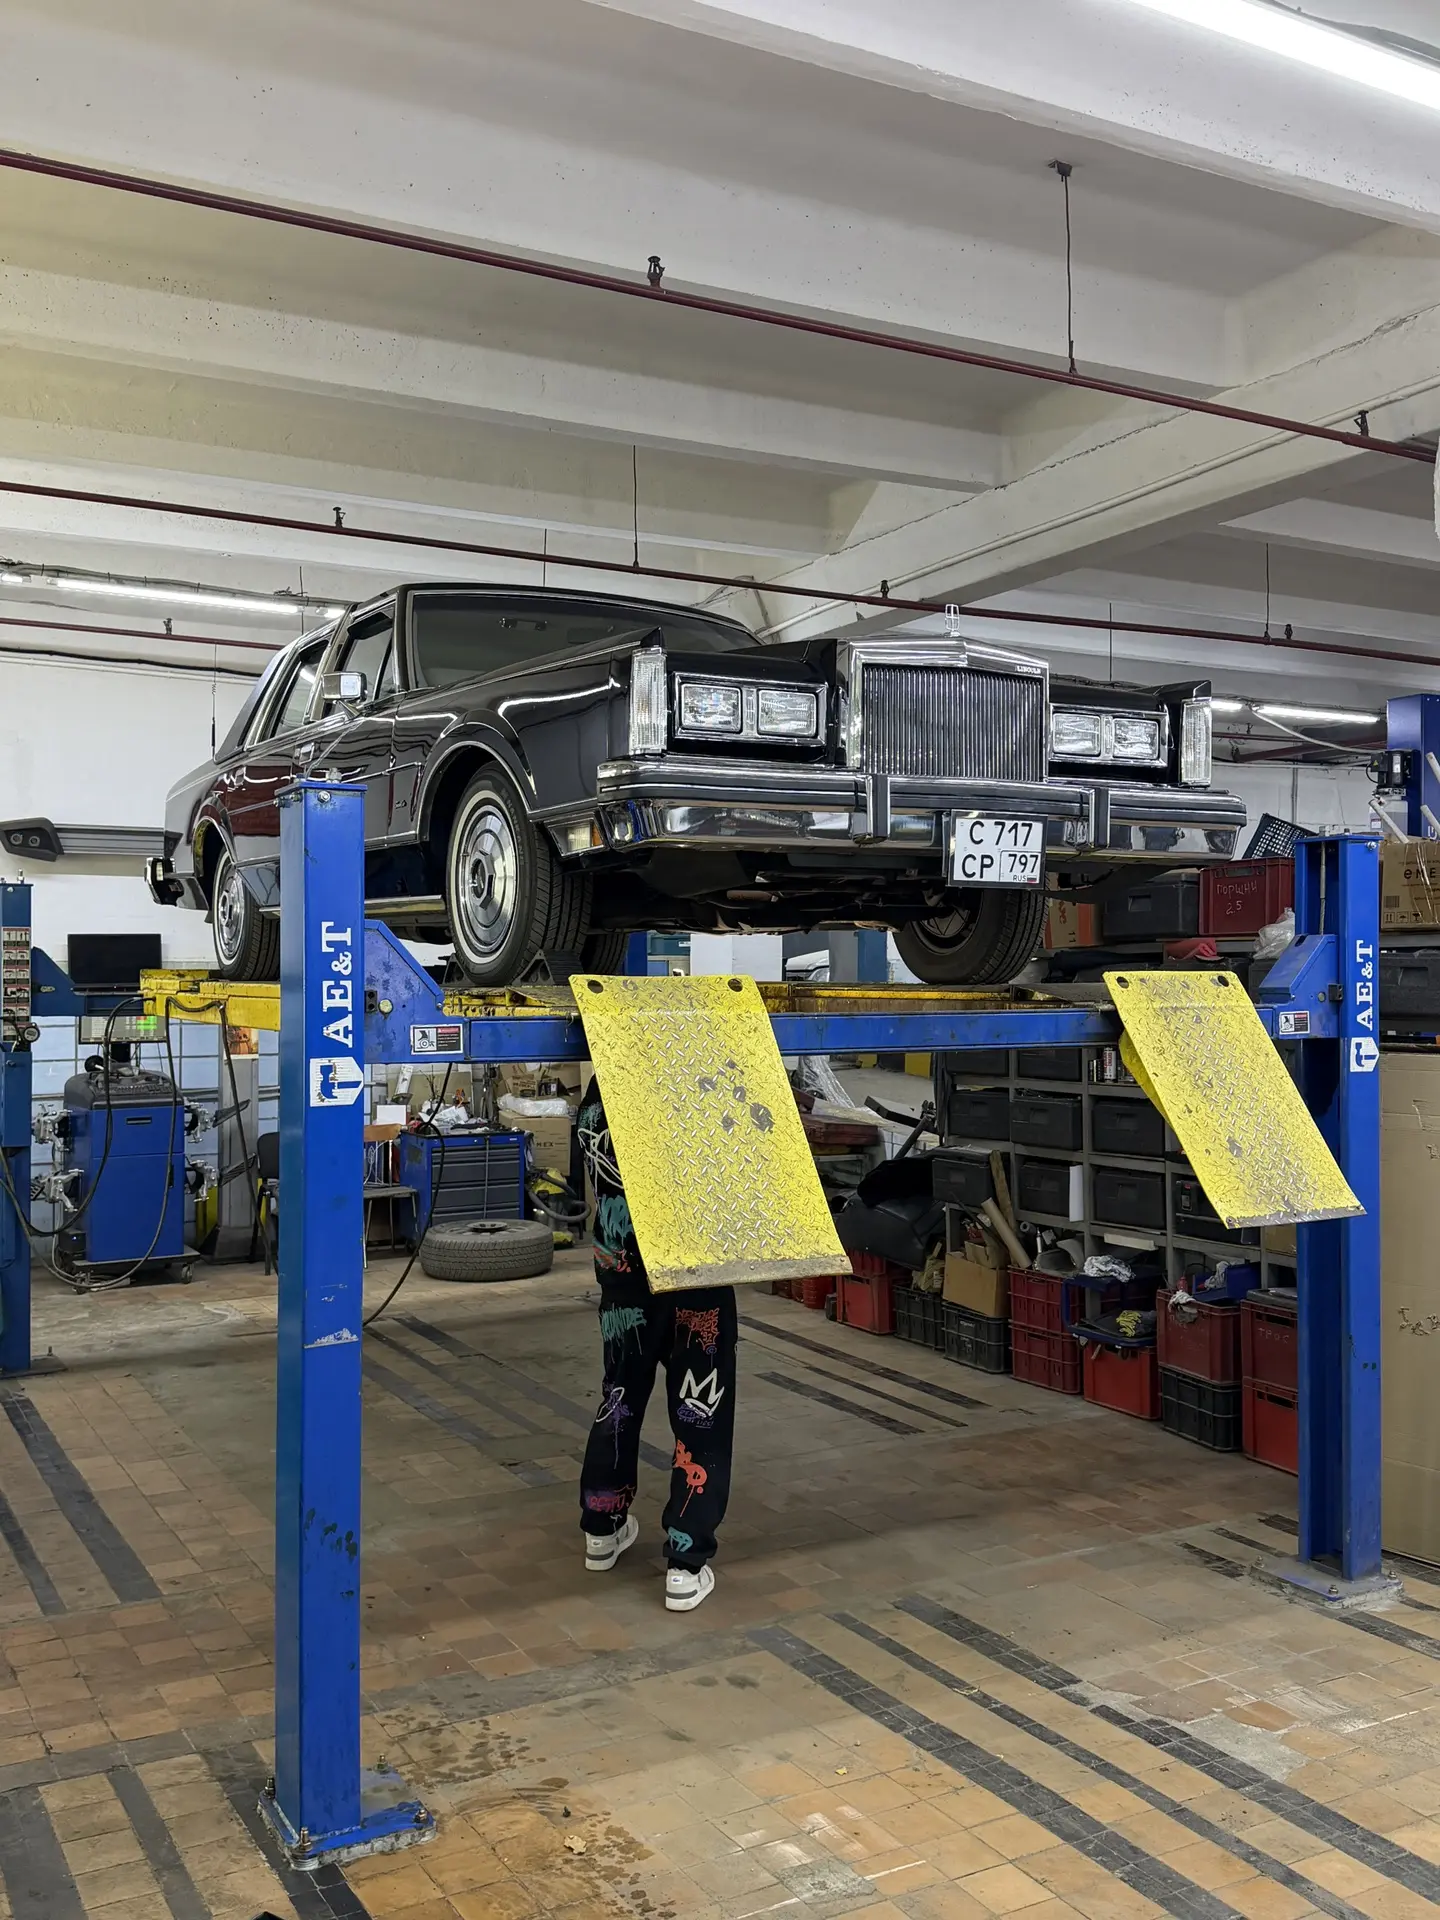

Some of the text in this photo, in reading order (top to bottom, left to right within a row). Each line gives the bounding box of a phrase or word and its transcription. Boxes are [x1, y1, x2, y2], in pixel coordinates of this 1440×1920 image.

[993, 821, 1033, 847] 717
[1007, 853, 1039, 874] 797
[1012, 874, 1027, 882] RUS
[1225, 900, 1243, 915] 2.5
[321, 921, 354, 1049] AE&T
[1356, 939, 1374, 1032] AE&T
